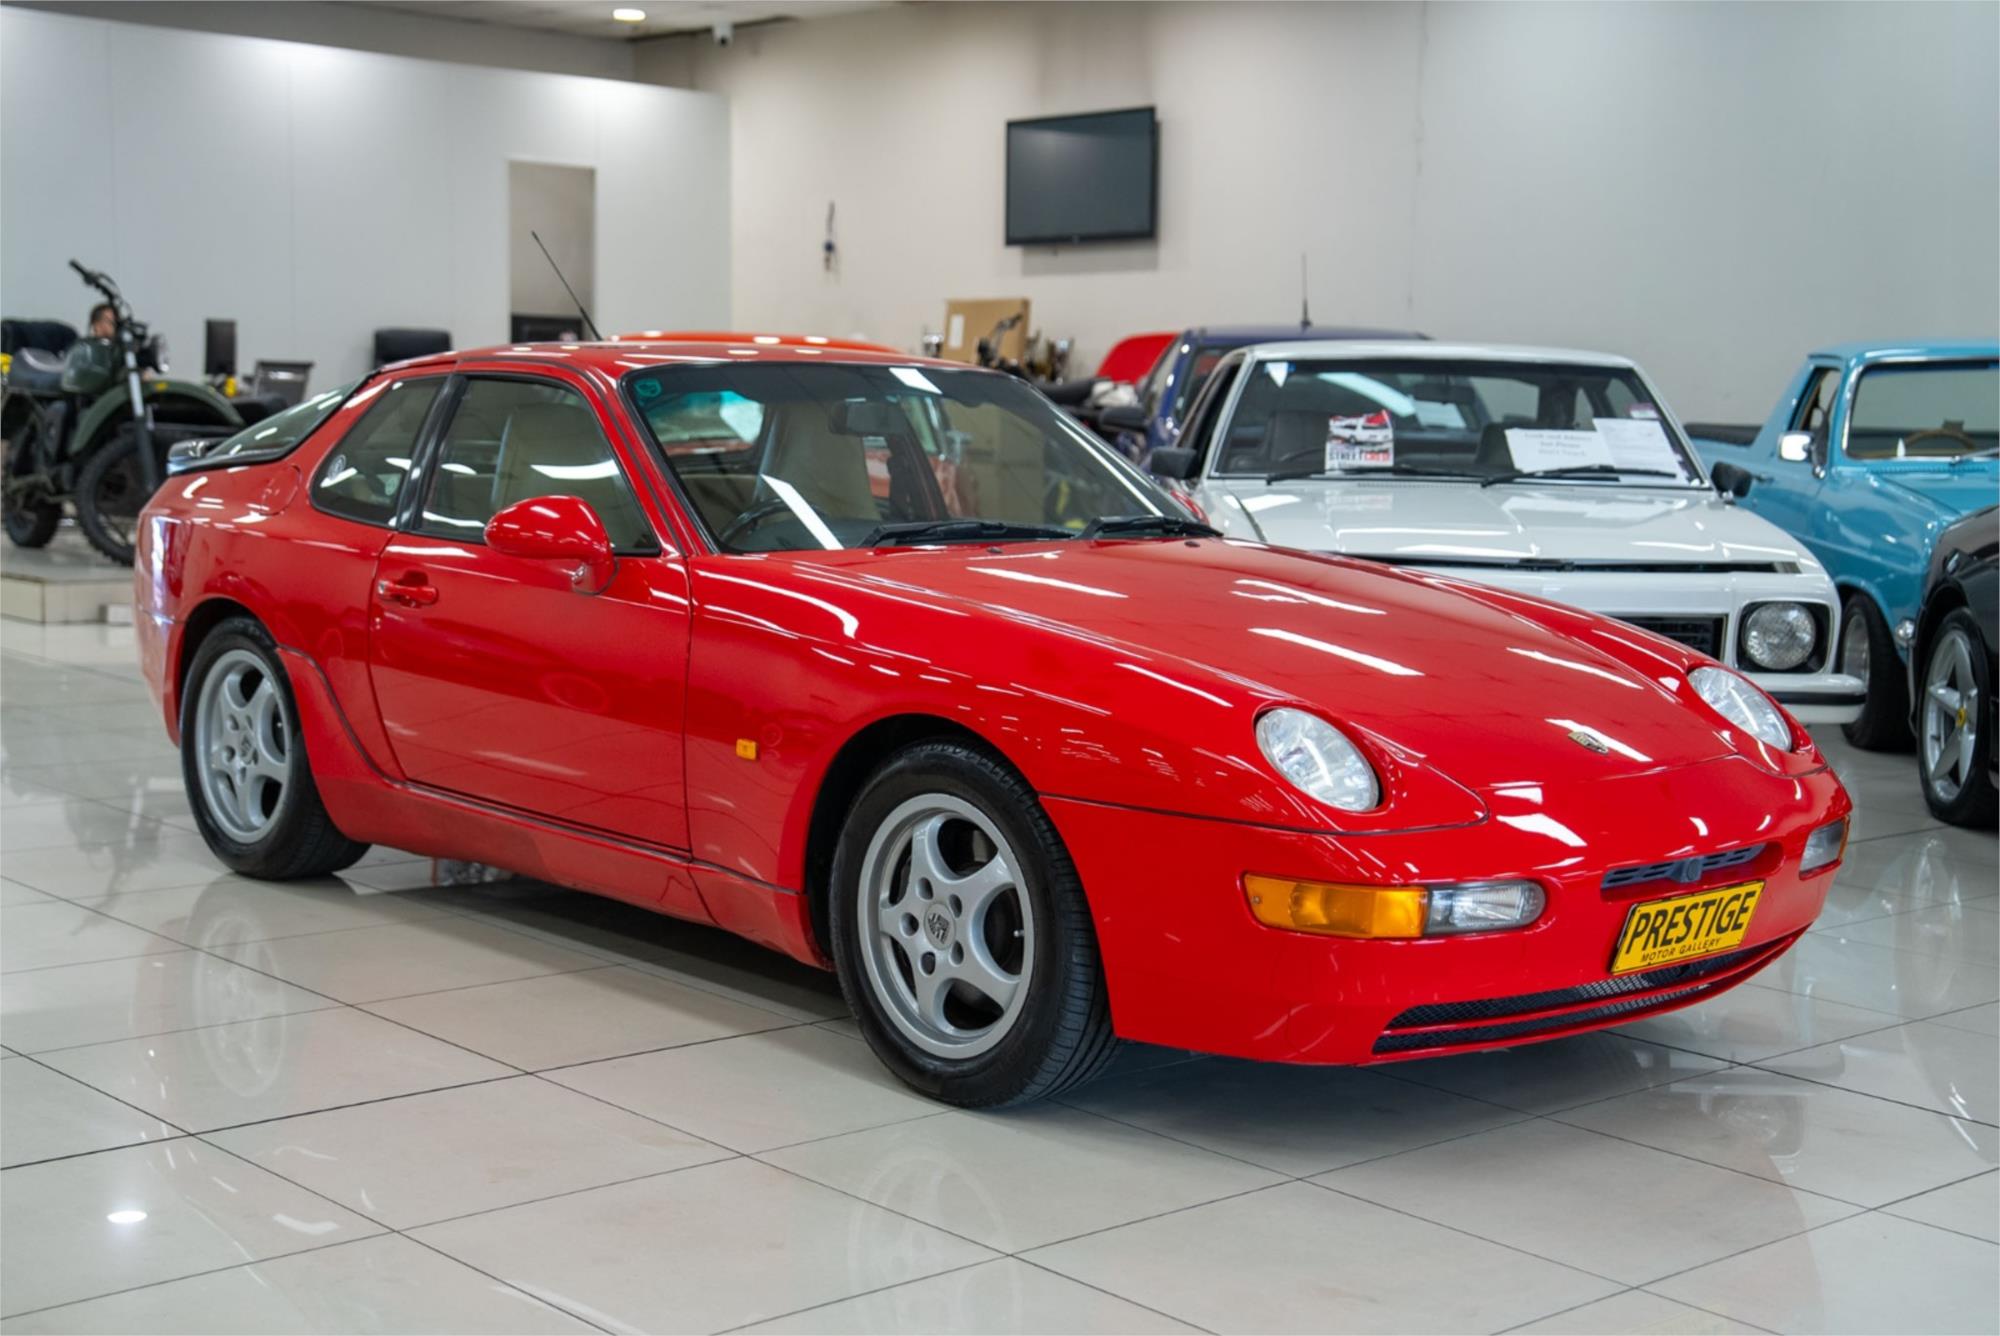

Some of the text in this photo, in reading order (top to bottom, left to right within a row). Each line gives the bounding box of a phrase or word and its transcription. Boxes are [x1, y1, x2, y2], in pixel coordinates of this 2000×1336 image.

[1626, 890, 1757, 955] PRESTIGE
[1641, 937, 1722, 962] MOTOR GALLERY
